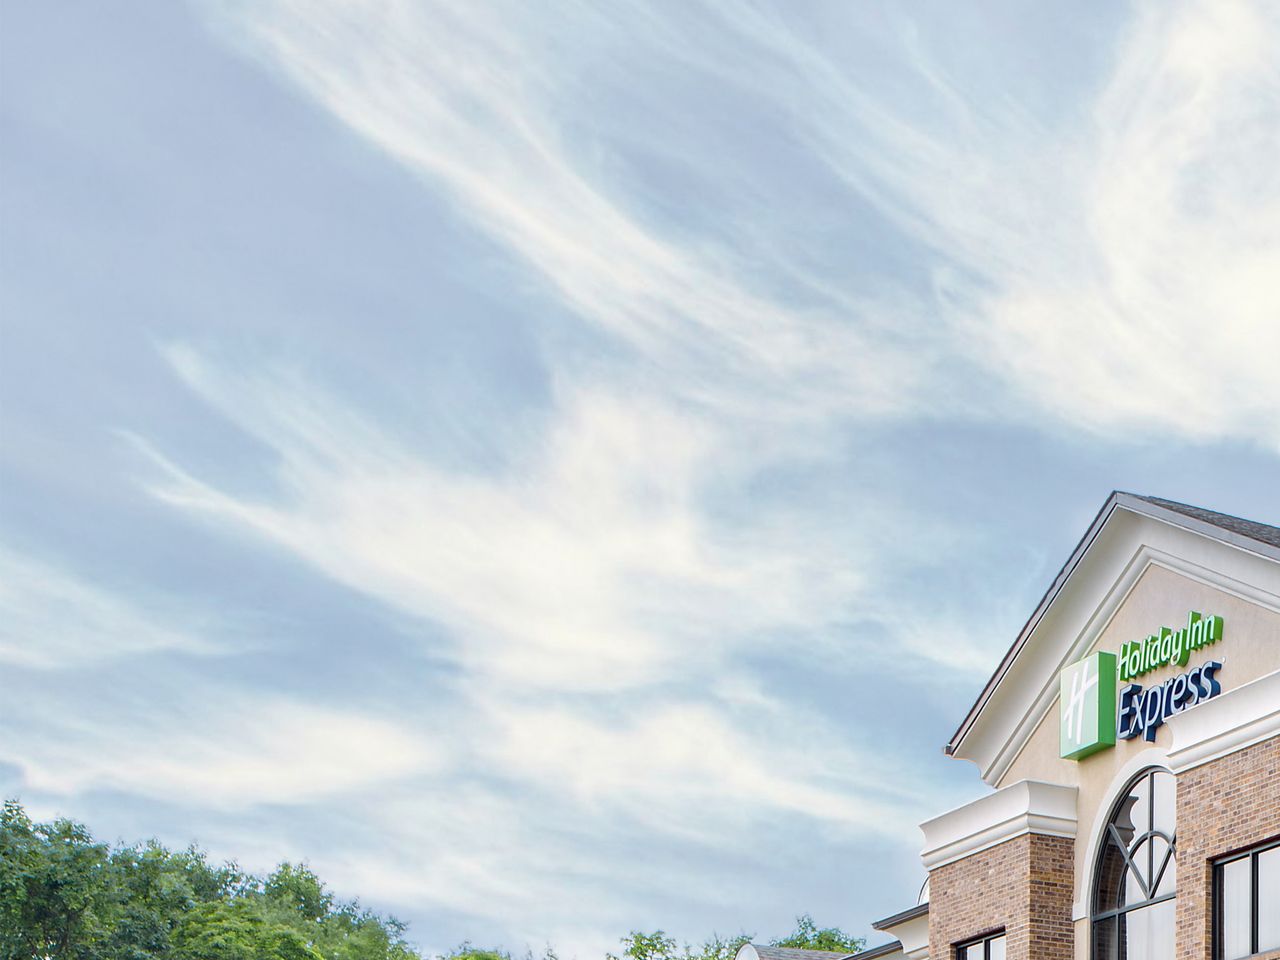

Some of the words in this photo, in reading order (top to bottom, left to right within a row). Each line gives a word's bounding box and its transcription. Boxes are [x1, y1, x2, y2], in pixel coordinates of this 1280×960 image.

[1116, 626, 1191, 682] Holiday
[1184, 610, 1223, 652] Inn
[1116, 660, 1222, 743] Express
